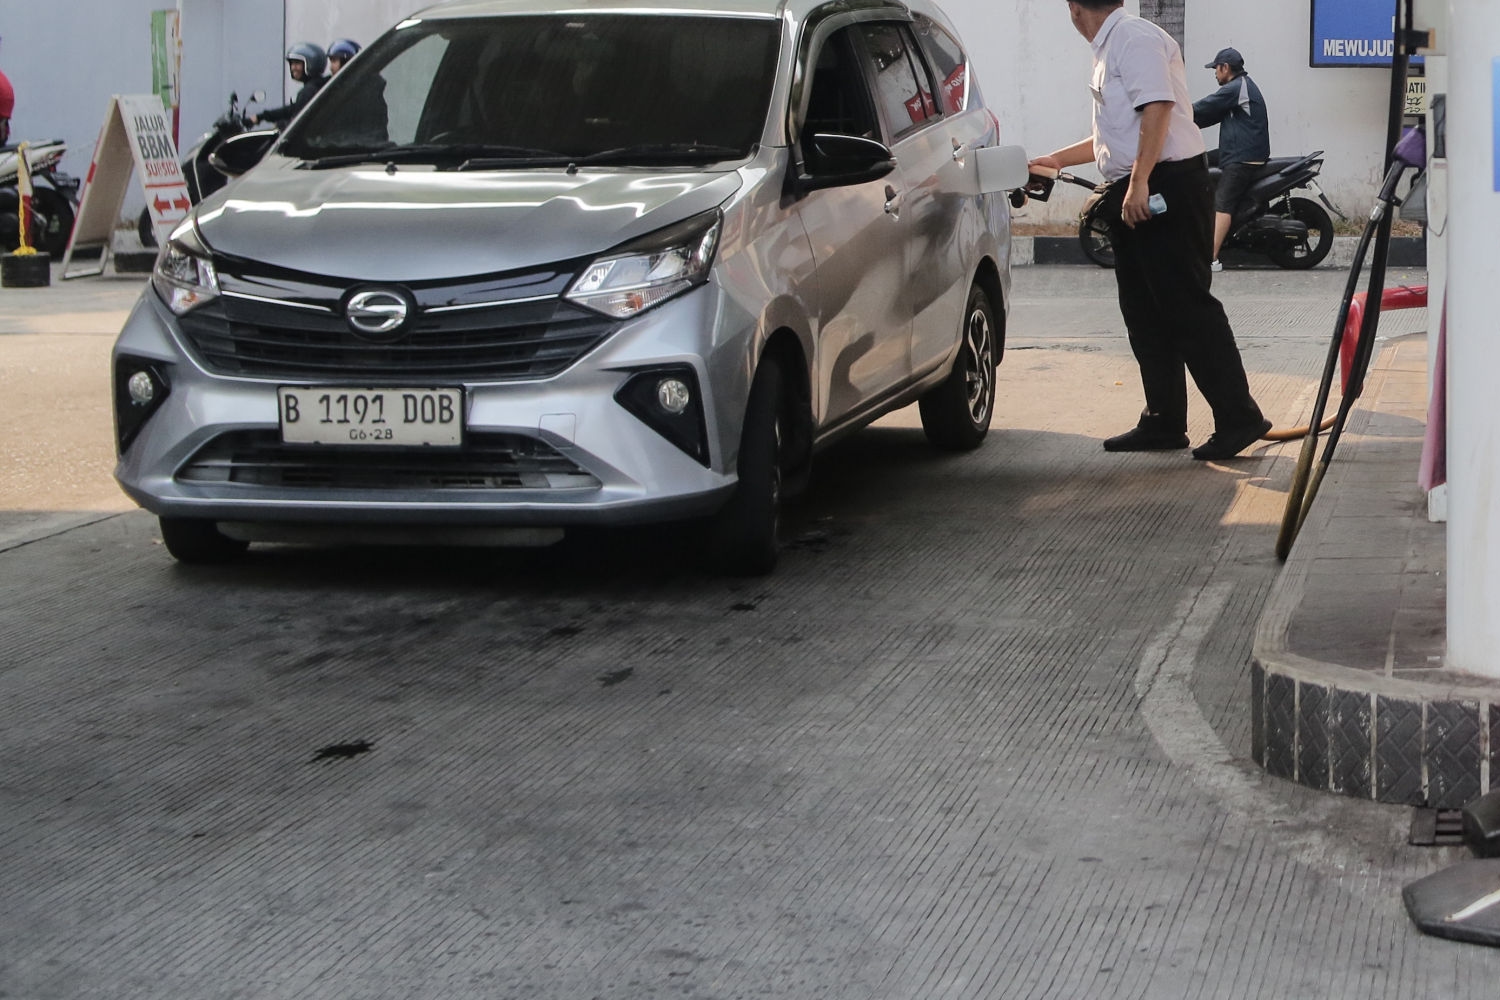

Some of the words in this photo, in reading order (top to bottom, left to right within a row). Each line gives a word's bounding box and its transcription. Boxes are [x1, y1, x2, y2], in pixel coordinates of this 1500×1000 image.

[1323, 39, 1395, 57] MEWUJUD
[134, 114, 166, 132] JALUR
[138, 134, 174, 159] BBM
[284, 394, 300, 424] B
[318, 393, 386, 424] 1191
[402, 393, 454, 424] DOB
